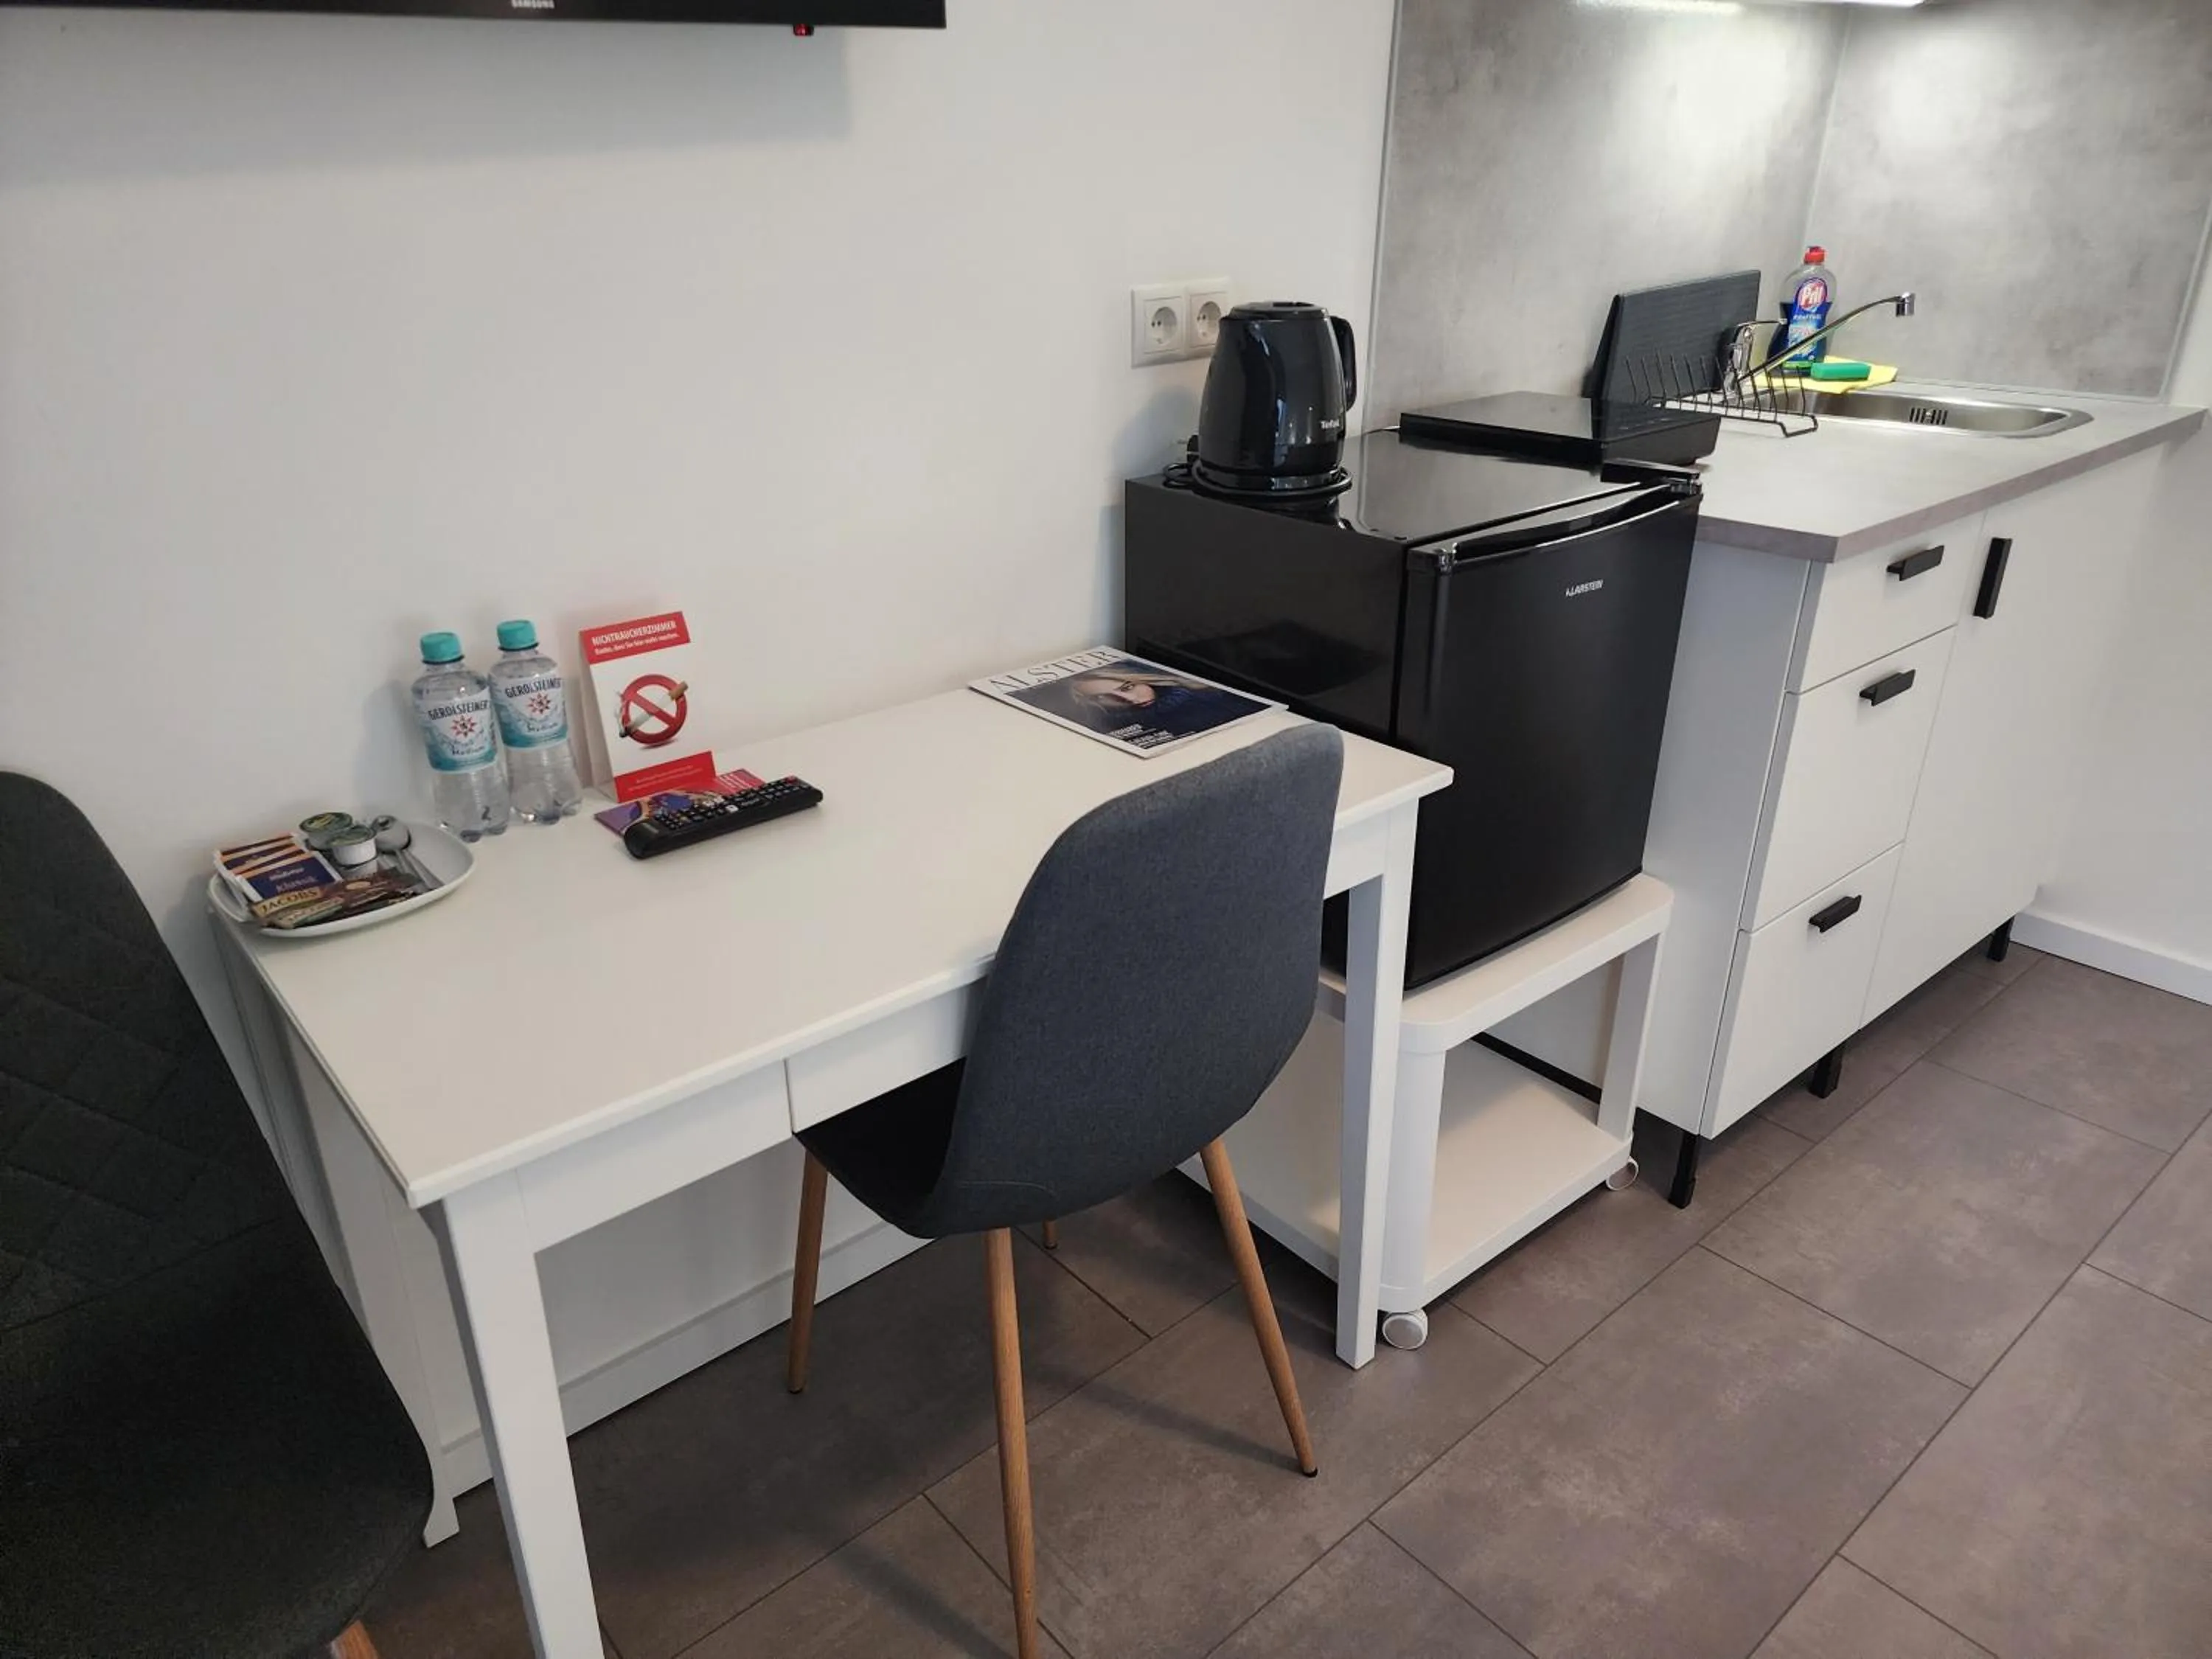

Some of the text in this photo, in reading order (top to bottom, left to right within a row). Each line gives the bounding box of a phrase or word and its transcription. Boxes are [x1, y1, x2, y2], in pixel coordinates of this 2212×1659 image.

[510, 0, 554, 9] SAMSUNG
[1801, 284, 1823, 307] Pril
[1321, 419, 1340, 428] Tefal
[591, 620, 677, 646] NICHTRAUCHERZIMMER
[990, 652, 1121, 690] ALSTER
[260, 890, 319, 914] JACOBS
